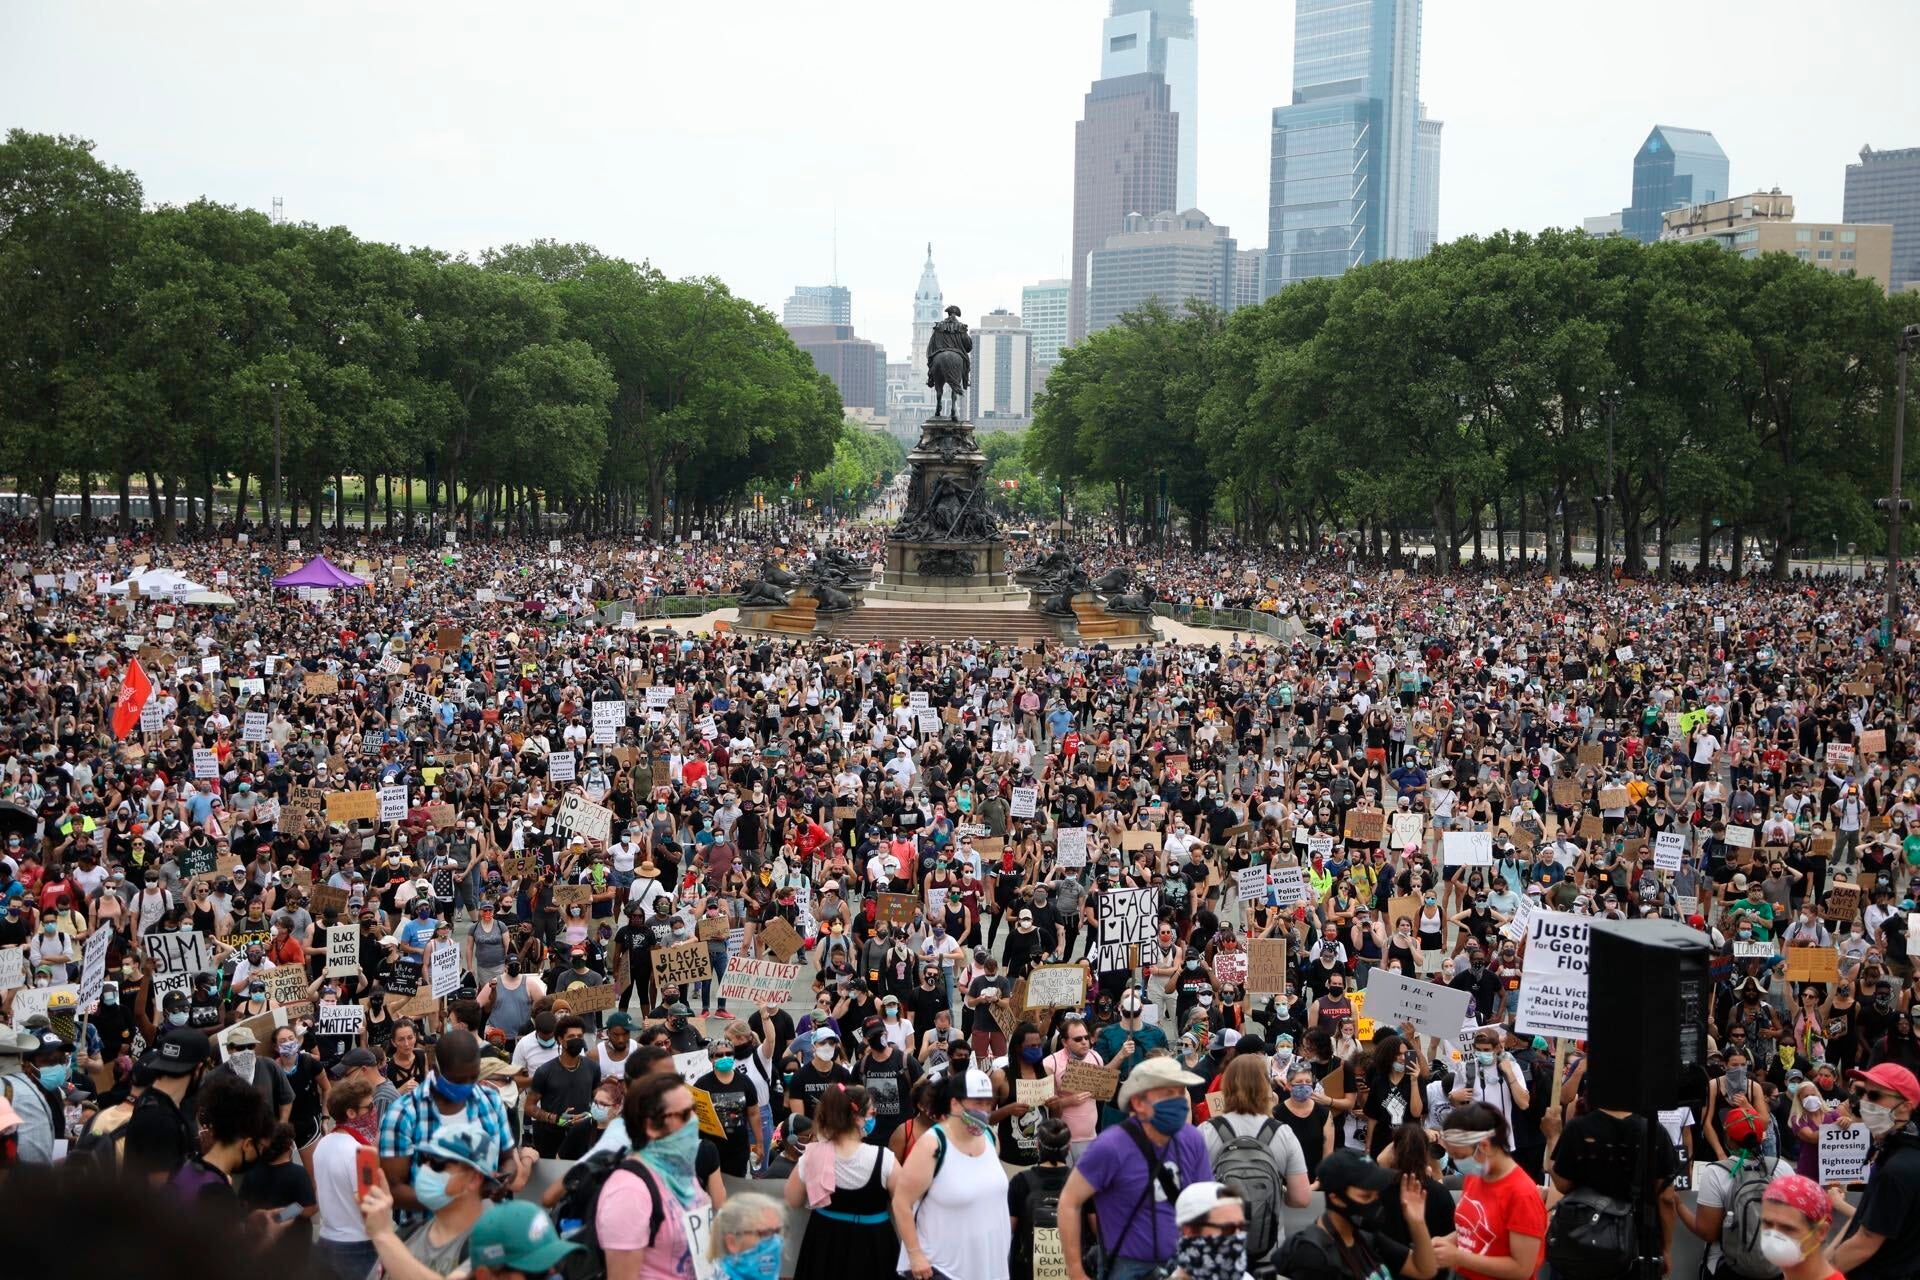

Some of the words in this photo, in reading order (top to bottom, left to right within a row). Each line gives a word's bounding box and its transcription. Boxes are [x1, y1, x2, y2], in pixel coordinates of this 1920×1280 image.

[404, 690, 432, 704] BLACK
[593, 710, 610, 718] KNEE
[612, 709, 623, 717] OFF
[364, 736, 383, 744] LIVES
[563, 796, 578, 810] NO
[579, 800, 611, 820] JUSTICE
[560, 813, 574, 827] NO
[1401, 824, 1414, 832] BLM
[1661, 835, 1680, 844] STOP
[185, 852, 213, 865] JUSTICE!
[1242, 868, 1262, 879] STOP
[1273, 876, 1300, 885] Racist
[1277, 887, 1301, 895] Police
[1278, 893, 1302, 901] Terror!
[1834, 887, 1857, 898] BLACK
[1100, 887, 1159, 918] BLACK
[1831, 898, 1853, 908] LIVES
[1827, 907, 1856, 919] MATTER
[1099, 915, 1159, 944] LIVES
[1532, 918, 1589, 941] Justi
[231, 933, 250, 947] BAD
[332, 931, 355, 943] BLACK
[333, 944, 355, 954] LIVES
[1534, 941, 1548, 950] for
[1549, 939, 1589, 956] Geor
[146, 934, 202, 974] BLM
[433, 948, 457, 964] Justice
[660, 947, 699, 964] BLACK
[1099, 941, 1159, 971] MATTER
[1215, 954, 1236, 963] BRING
[329, 955, 356, 967] MATTER
[438, 955, 457, 966] George
[441, 961, 456, 971] Floyd
[669, 957, 709, 972] LIVES
[1557, 955, 1590, 973] Floy
[394, 964, 413, 972] White
[727, 957, 761, 975] BLACK
[764, 962, 799, 980] LIVES
[257, 972, 271, 981] THE
[394, 971, 416, 980] Silence
[658, 966, 708, 985] MATTER
[386, 983, 417, 996] Violence
[753, 977, 770, 987] MORE
[773, 979, 795, 990] THAN
[720, 985, 747, 998] WHITE
[1540, 985, 1561, 996] ALL
[1565, 986, 1587, 999] Vict
[1534, 996, 1570, 1008] Racist
[322, 1006, 343, 1018] BLACK
[344, 1006, 362, 1016] LIVES
[1552, 1010, 1588, 1022] Violen
[319, 1018, 362, 1033] MATTER
[1459, 1033, 1476, 1042] BLA
[1826, 1129, 1860, 1141] STOP
[1821, 1142, 1866, 1151] Repressing
[1825, 1167, 1863, 1176] Protest!
[1038, 1229, 1061, 1241] STO
[1034, 1243, 1064, 1255] KILLI
[1039, 1256, 1064, 1265] BLAC
[1037, 1268, 1068, 1277] PEOPL
